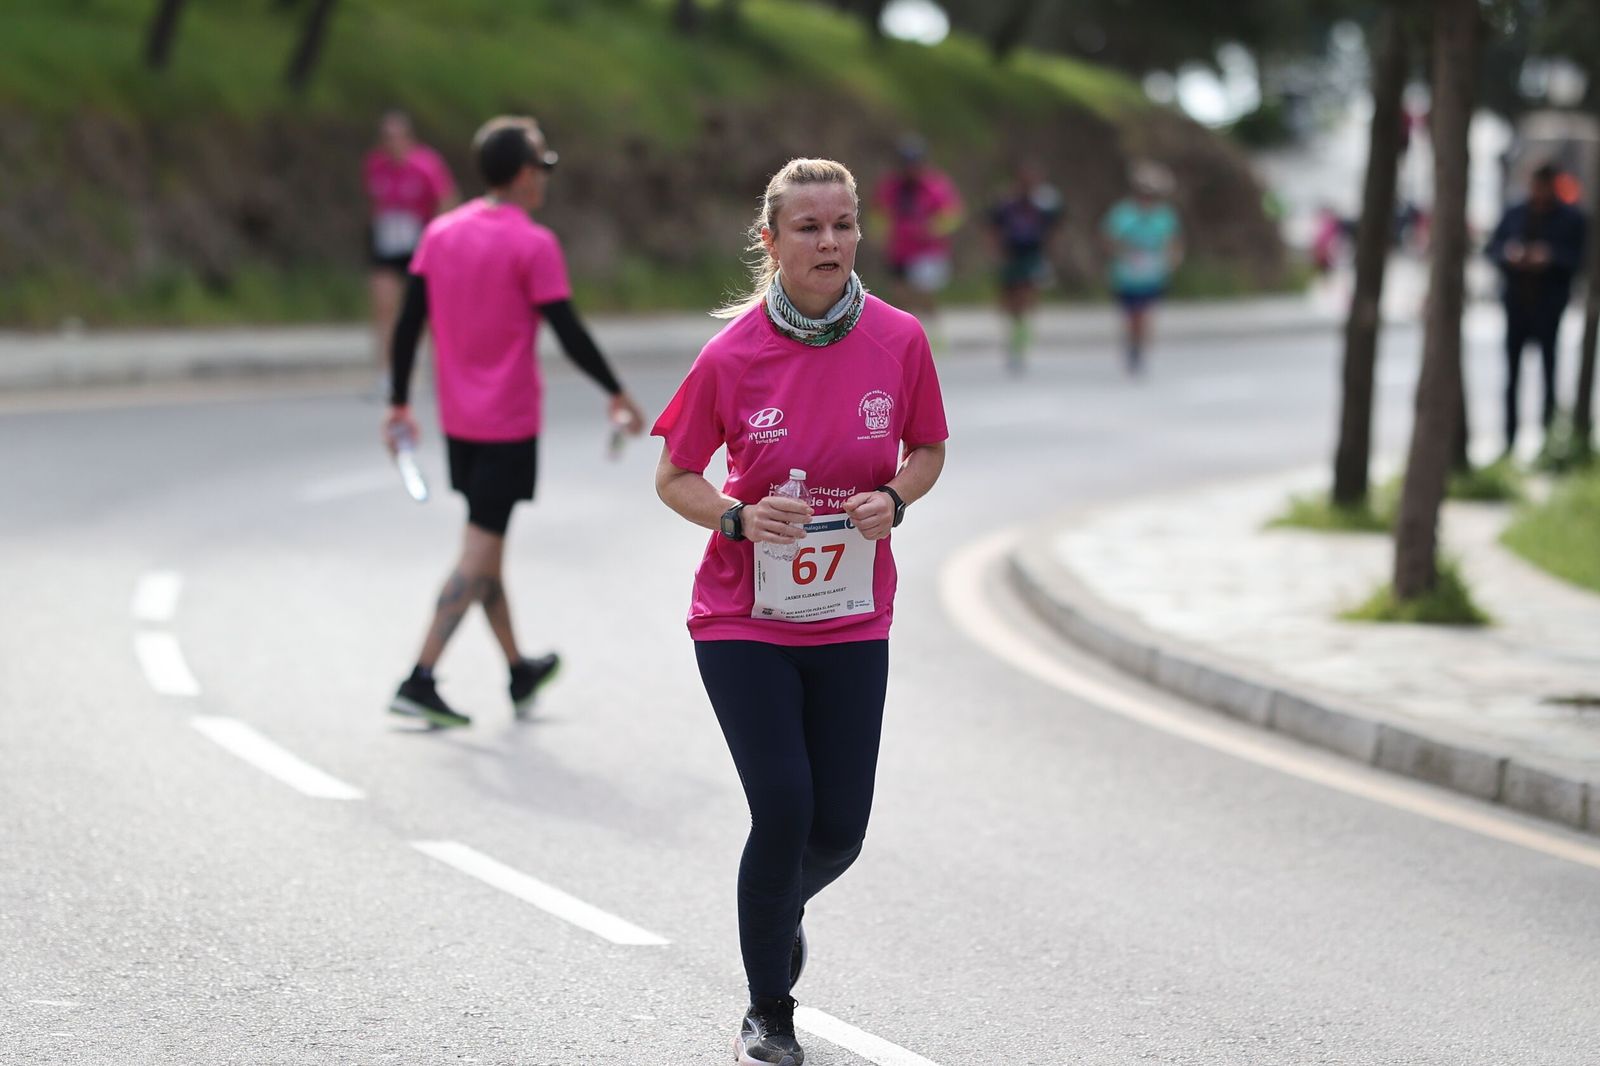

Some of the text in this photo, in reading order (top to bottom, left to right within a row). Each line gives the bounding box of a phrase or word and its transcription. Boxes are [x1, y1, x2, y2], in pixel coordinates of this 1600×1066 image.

[748, 428, 788, 441] HYUNDAI
[808, 486, 856, 497] ciudad
[792, 543, 846, 586] 67
